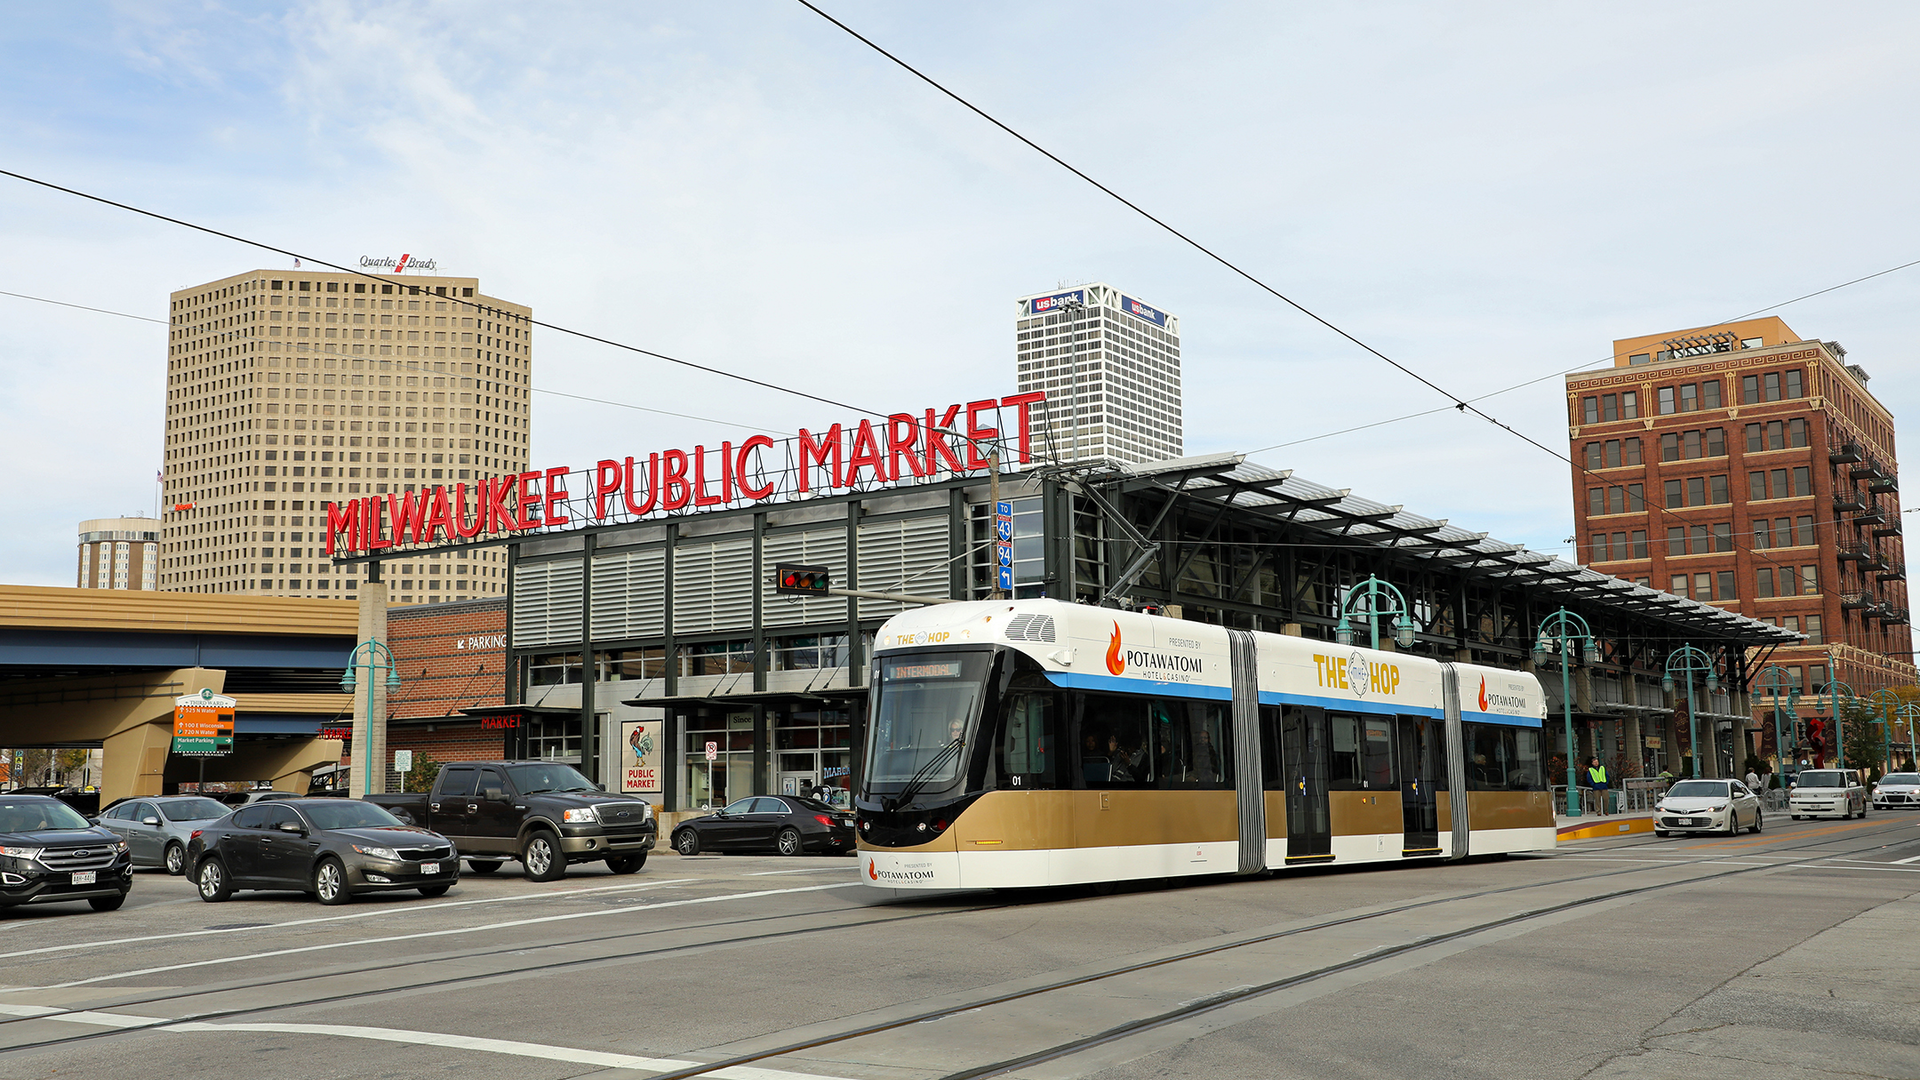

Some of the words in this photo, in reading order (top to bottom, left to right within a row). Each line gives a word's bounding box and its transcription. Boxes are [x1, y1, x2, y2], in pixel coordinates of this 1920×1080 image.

[360, 255, 396, 267] Quarles
[406, 256, 437, 270] Brady
[326, 467, 570, 555] MILWAUKEE
[595, 434, 774, 519] PUBLIC
[798, 391, 1047, 493] MARKET
[1000, 504, 1008, 513] TO
[998, 521, 1010, 536] 43
[998, 546, 1010, 562] 94
[468, 634, 507, 650] PARKING
[897, 634, 915, 645] THE
[928, 632, 950, 642] HOP
[1169, 638, 1194, 648] PRESENTED
[1195, 641, 1202, 650] BY
[1127, 650, 1202, 673] POTAWATOMI
[896, 664, 952, 678] INTERMODAL
[1314, 654, 1348, 690] THE
[1370, 662, 1400, 695] HOP
[1488, 694, 1526, 708] POTAWATOMI
[481, 714, 522, 730] MARKET
[733, 716, 752, 724] Since
[324, 727, 353, 740] MARKE
[628, 769, 654, 778] PUBLIC
[626, 780, 655, 788] MARKET
[1012, 776, 1021, 786] 01
[878, 870, 934, 879] POTAWATOMI
